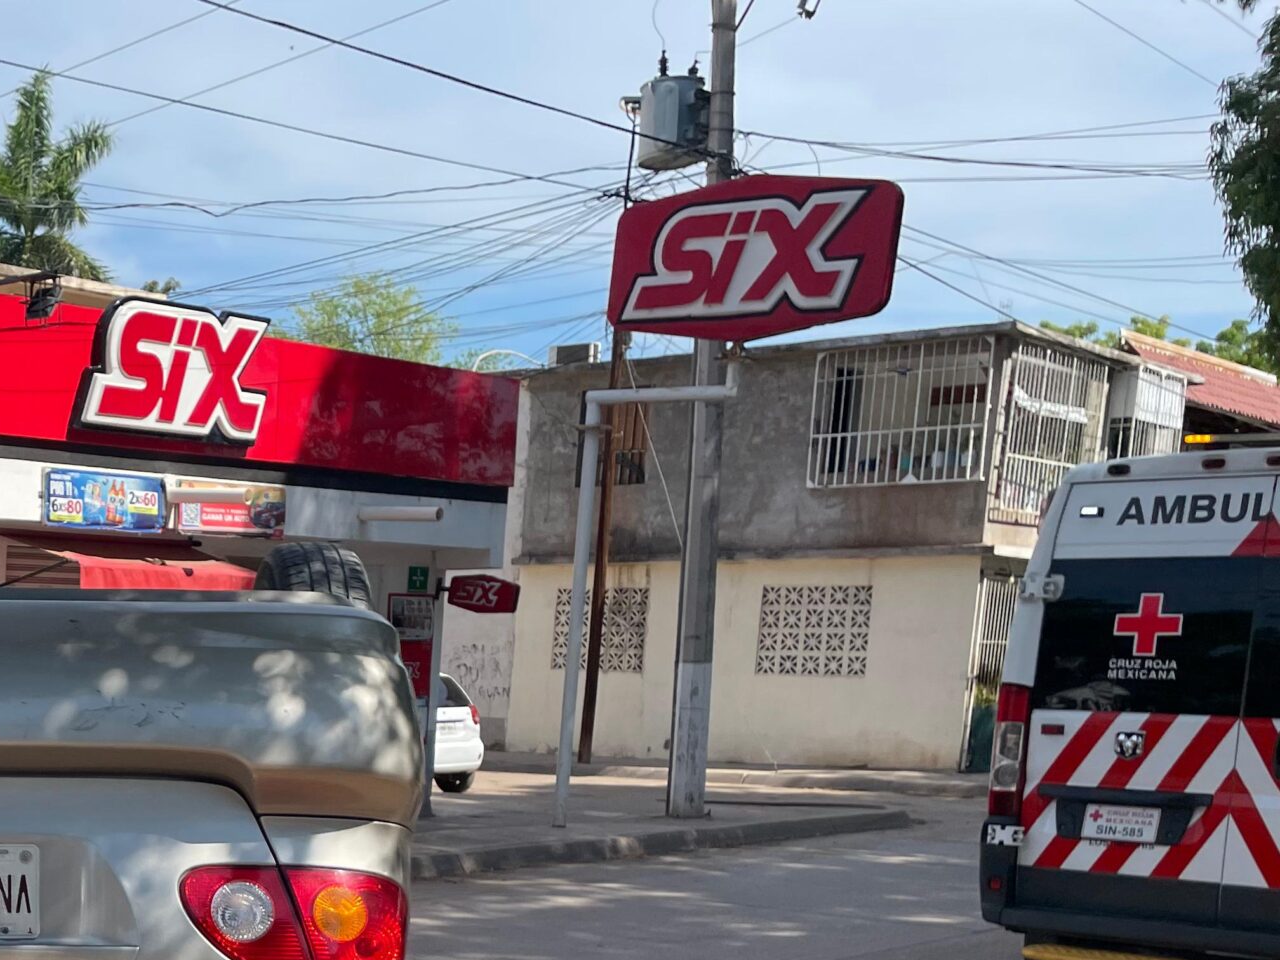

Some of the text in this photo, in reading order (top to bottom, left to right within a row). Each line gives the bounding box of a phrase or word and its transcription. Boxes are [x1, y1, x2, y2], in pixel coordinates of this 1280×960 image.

[1109, 658, 1177, 669] CRUZ ROJA
[1107, 669, 1176, 680] MEXICANA
